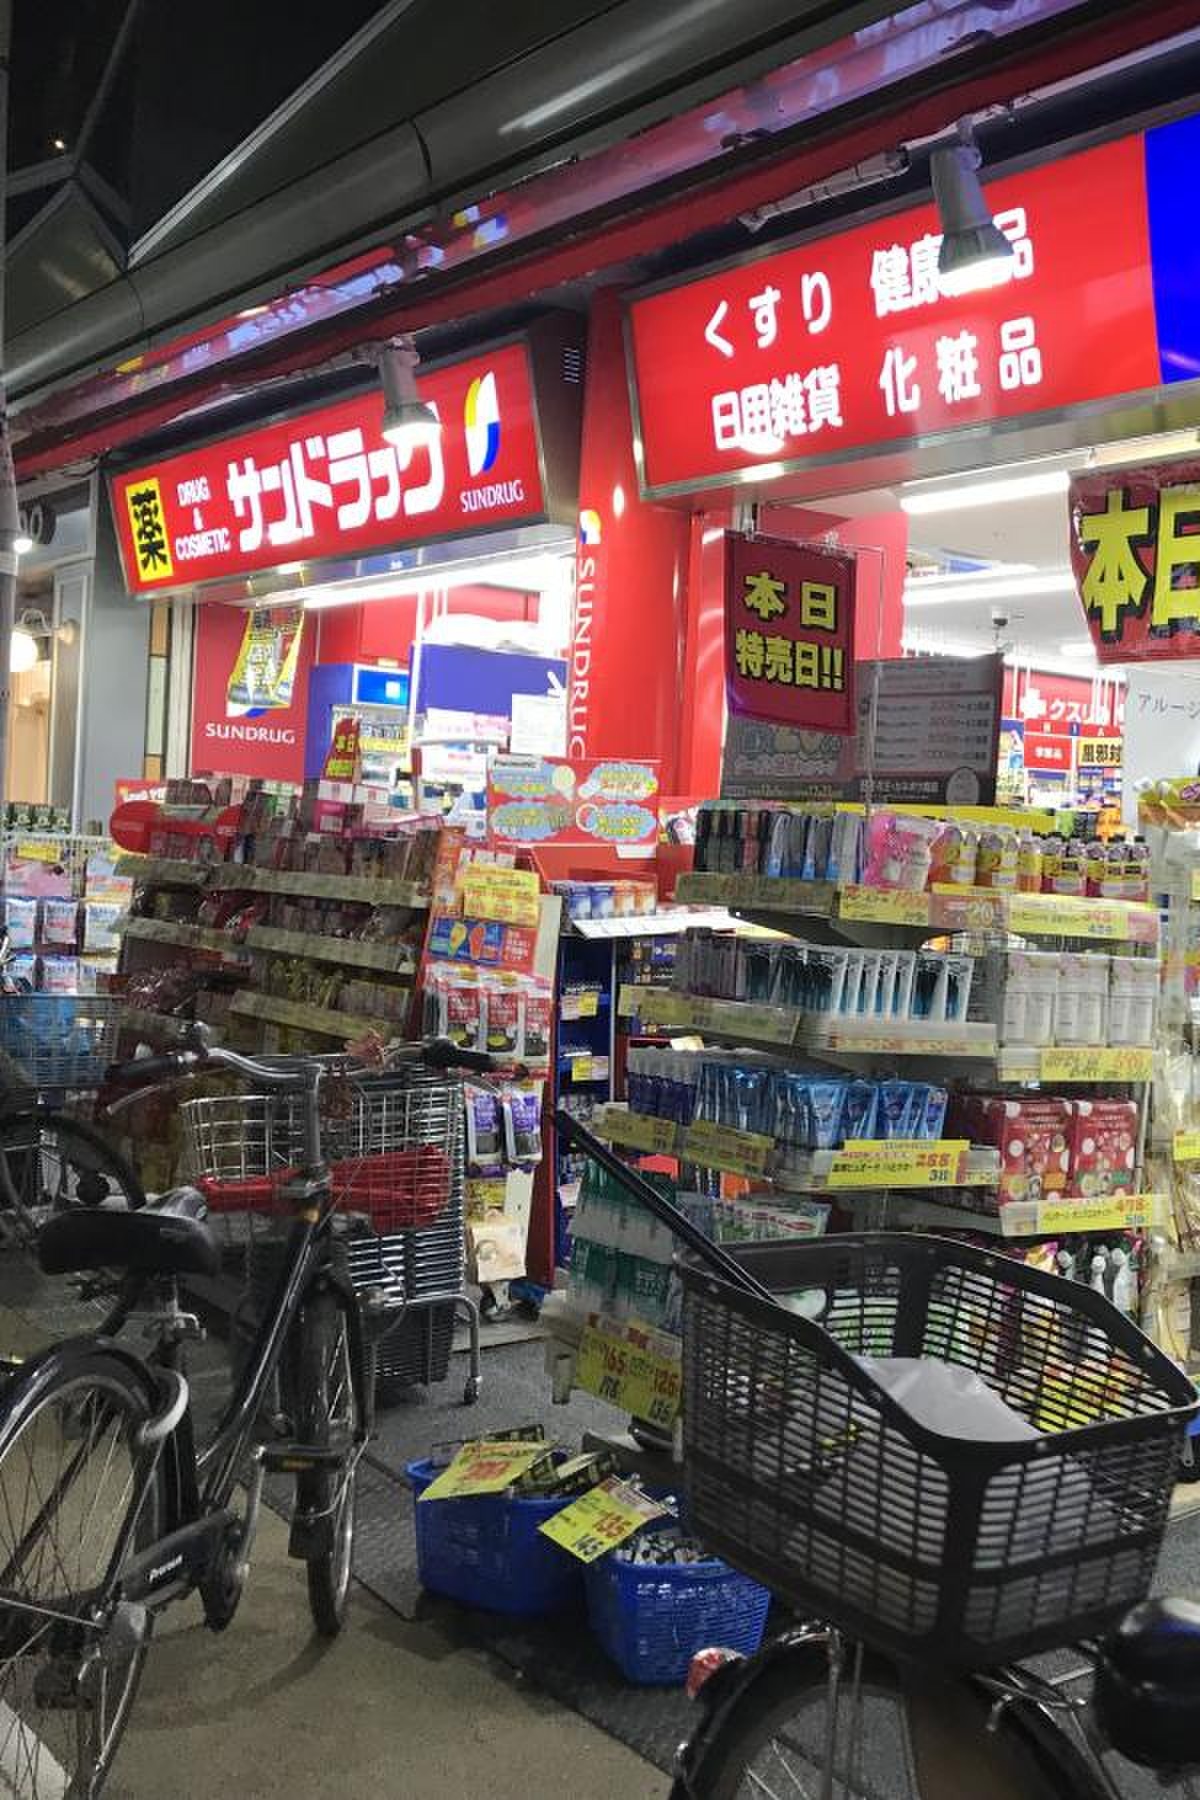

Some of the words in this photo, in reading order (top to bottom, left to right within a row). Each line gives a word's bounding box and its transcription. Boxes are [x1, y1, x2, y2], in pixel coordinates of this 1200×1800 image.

[704, 272, 832, 358] くすり
[870, 208, 1034, 317] 健康品
[711, 364, 844, 452] 日用雑貨
[879, 317, 1042, 416] 化粧品
[177, 477, 211, 507] DRUG
[460, 480, 525, 514] SUNDRUG
[130, 487, 170, 572] 薬
[176, 527, 231, 561] COSMETIC
[743, 571, 836, 630] 本日
[735, 629, 845, 690] 特売日!!
[205, 721, 296, 745] SUNDRUG
